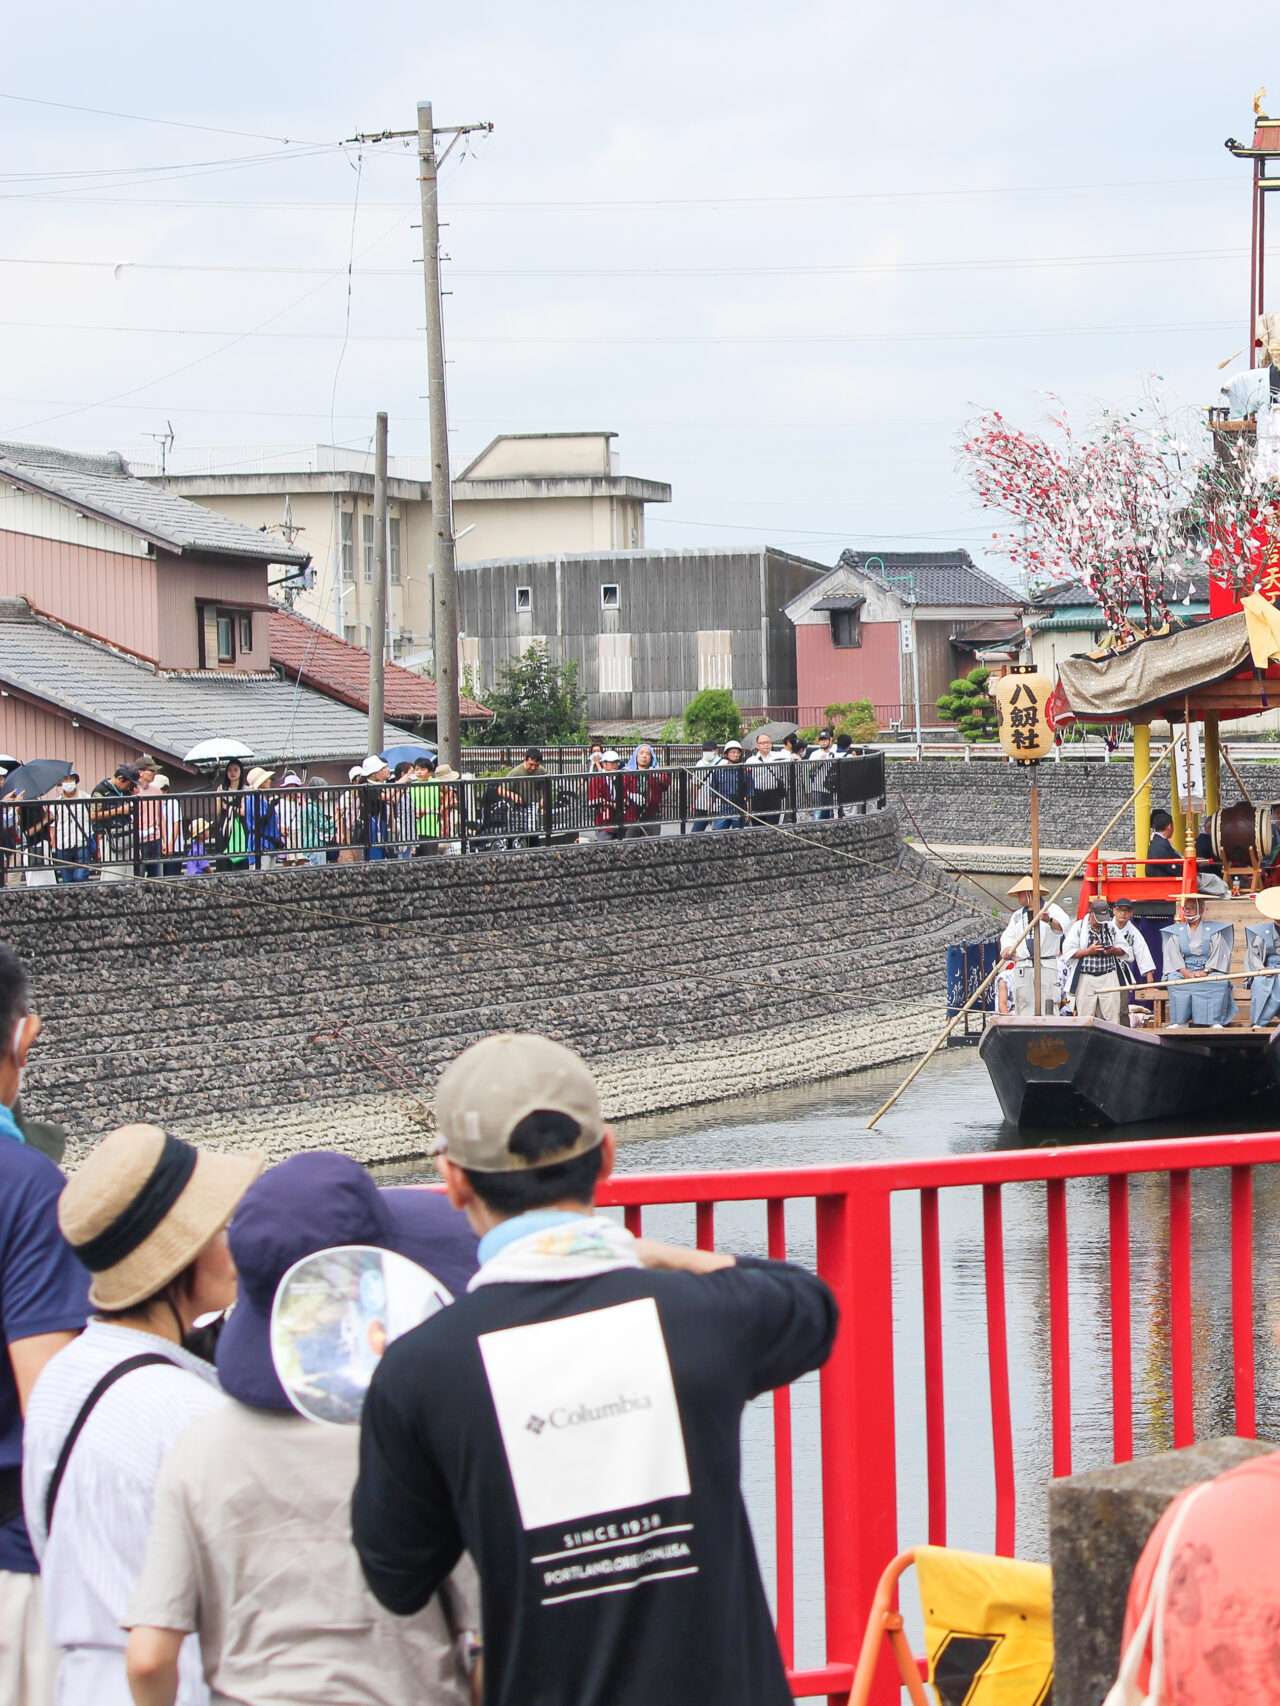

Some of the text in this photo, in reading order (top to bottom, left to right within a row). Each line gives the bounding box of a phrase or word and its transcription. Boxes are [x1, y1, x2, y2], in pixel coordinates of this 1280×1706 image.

[549, 1393, 652, 1430] Columbia
[563, 1513, 662, 1548] SINCE 1938
